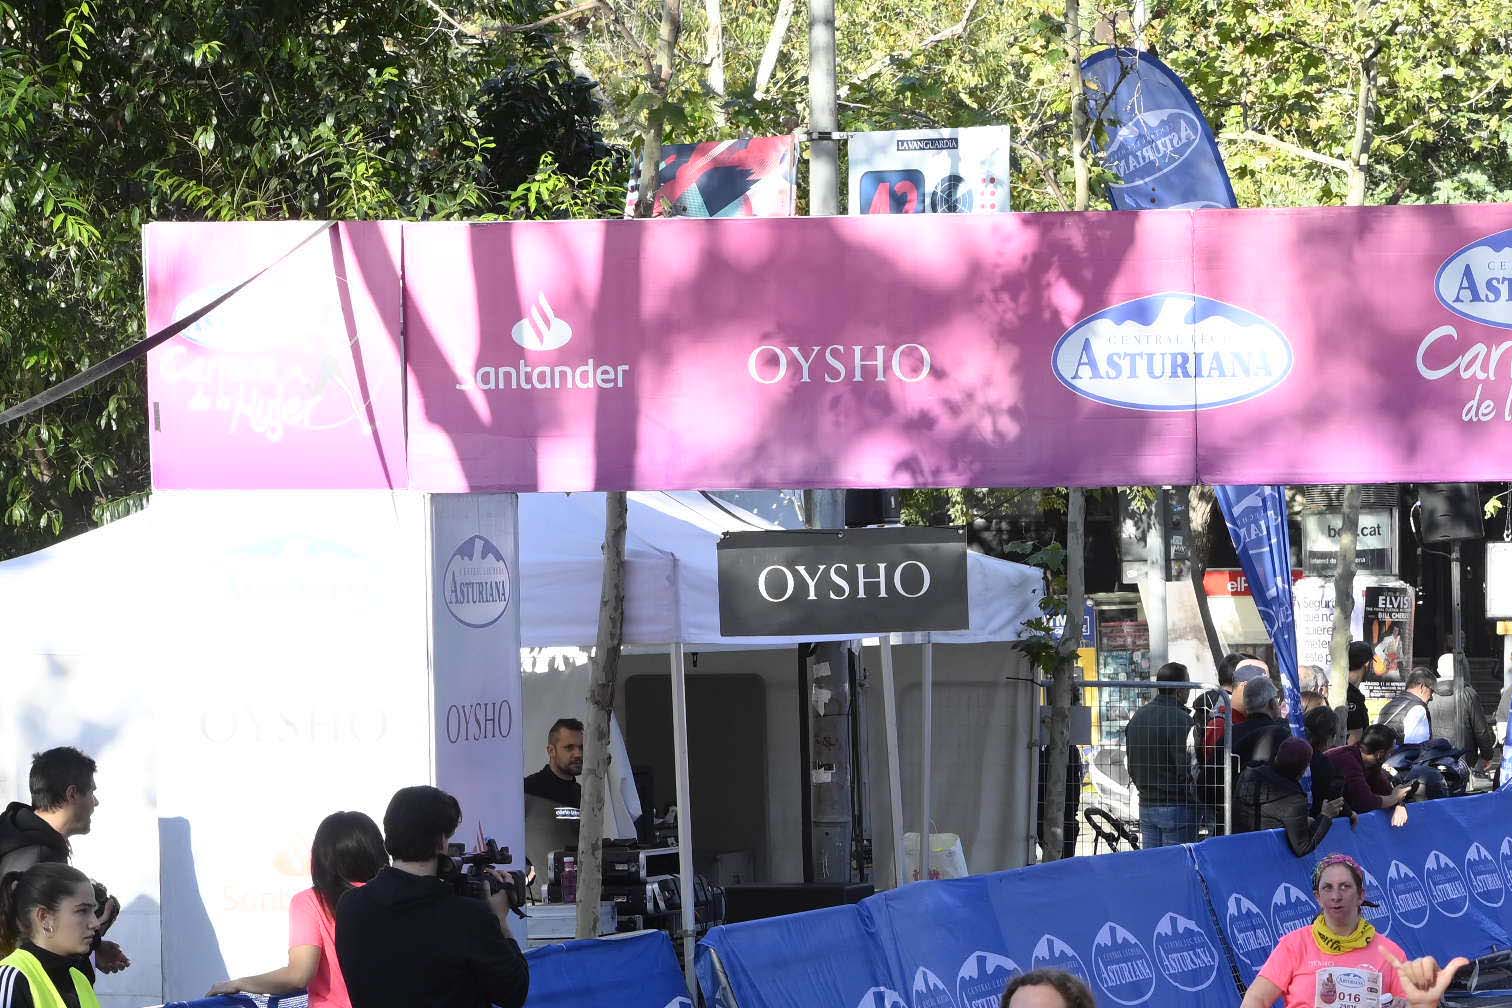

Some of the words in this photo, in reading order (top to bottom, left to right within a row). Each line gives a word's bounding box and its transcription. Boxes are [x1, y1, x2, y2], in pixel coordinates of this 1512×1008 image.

[748, 343, 932, 384] OYSHO
[1072, 334, 1274, 381] ASTURIANA
[1462, 390, 1494, 421] de
[449, 569, 507, 605] ASTURIANA
[757, 560, 931, 603] OYSHO
[1378, 596, 1409, 608] ELVIS
[446, 700, 513, 744] OYSHO
[1098, 954, 1154, 988] ASTURIANA
[1338, 991, 1361, 1003] 016
